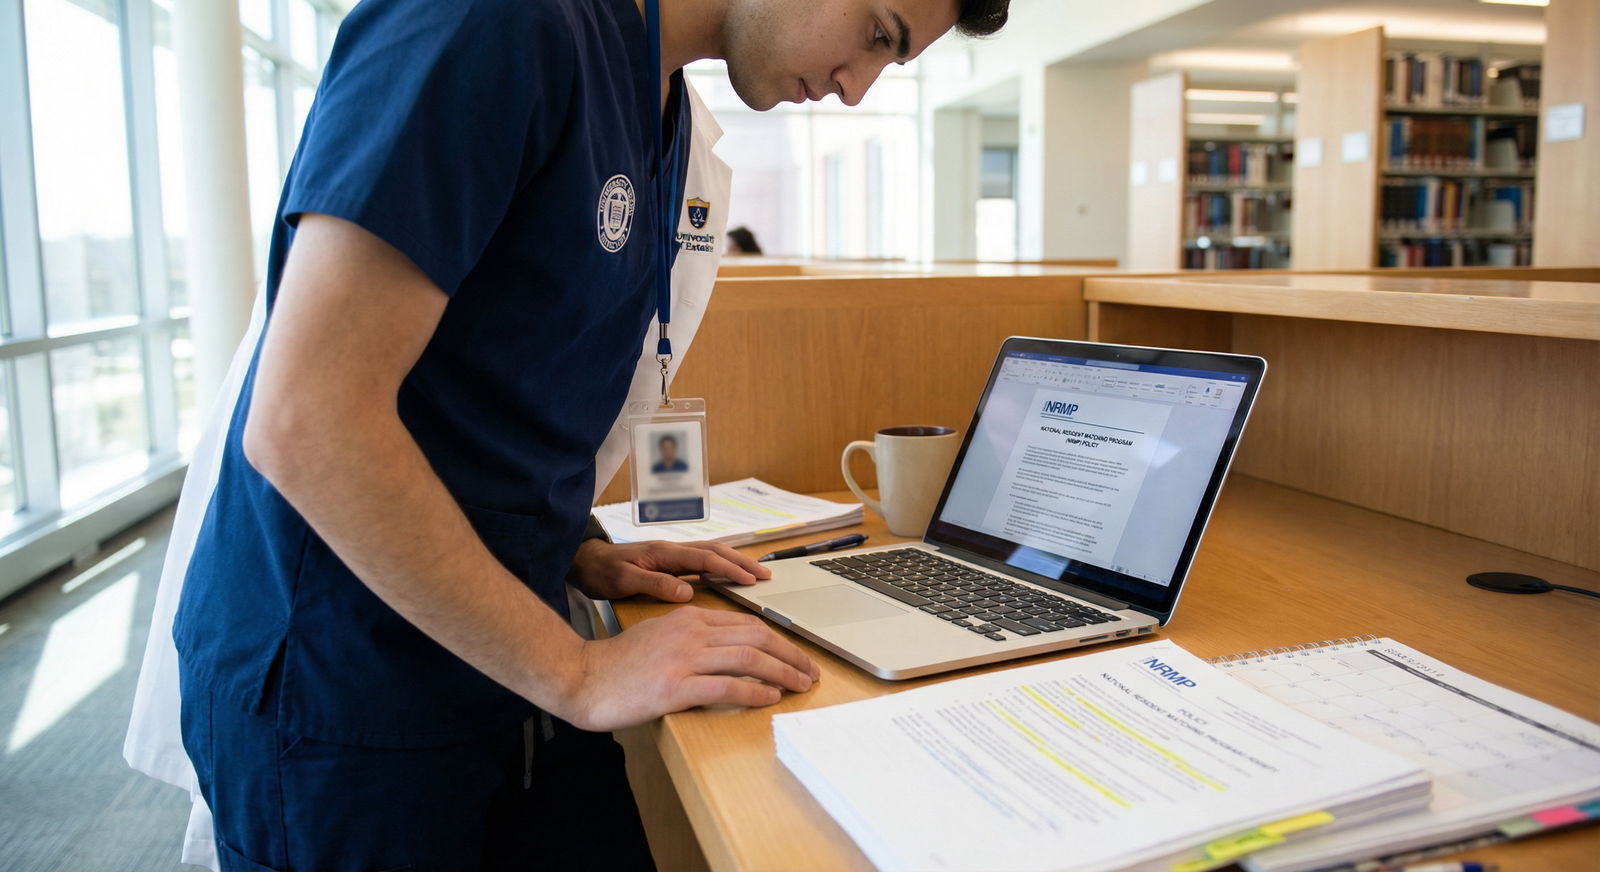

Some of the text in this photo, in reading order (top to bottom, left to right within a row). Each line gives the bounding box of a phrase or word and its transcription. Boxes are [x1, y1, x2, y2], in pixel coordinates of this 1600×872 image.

[1045, 400, 1079, 416] NRMP
[1143, 658, 1197, 688] NRMP
[1100, 672, 1132, 695] NATIONAL
[1176, 708, 1209, 725] POLICY
